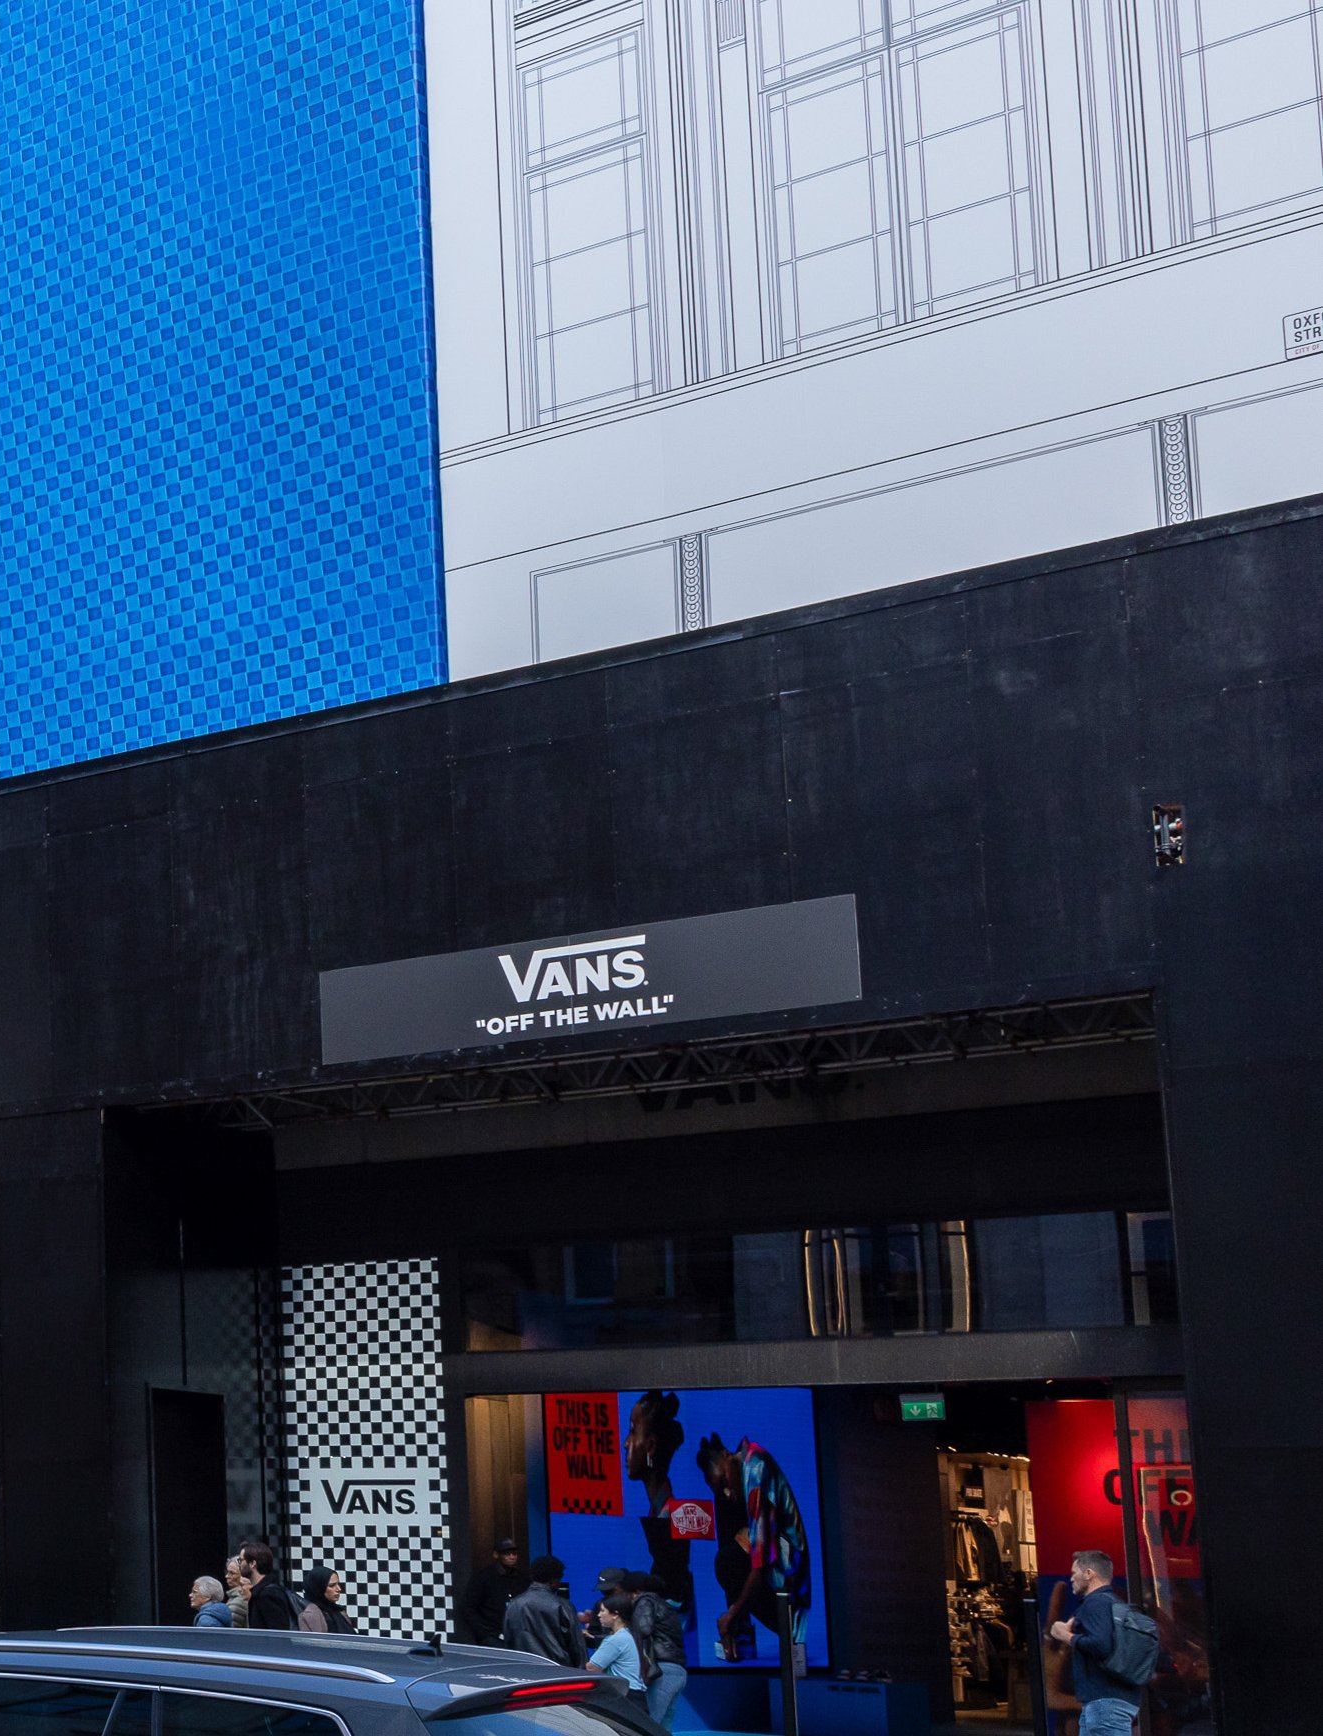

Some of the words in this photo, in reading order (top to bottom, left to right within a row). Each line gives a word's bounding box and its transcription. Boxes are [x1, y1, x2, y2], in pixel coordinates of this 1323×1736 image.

[1293, 312, 1323, 329] OXF
[1295, 346, 1310, 355] CITY
[498, 934, 649, 1003] VANS
[539, 1006, 589, 1028] THE
[593, 995, 674, 1021] WALL"
[556, 1399, 591, 1426] THIS
[594, 1403, 609, 1428] IS
[553, 1426, 581, 1452] OFF
[585, 1428, 615, 1455] THE
[1114, 1429, 1190, 1464] HI
[566, 1453, 608, 1481] WALL
[321, 1479, 416, 1514] VANS
